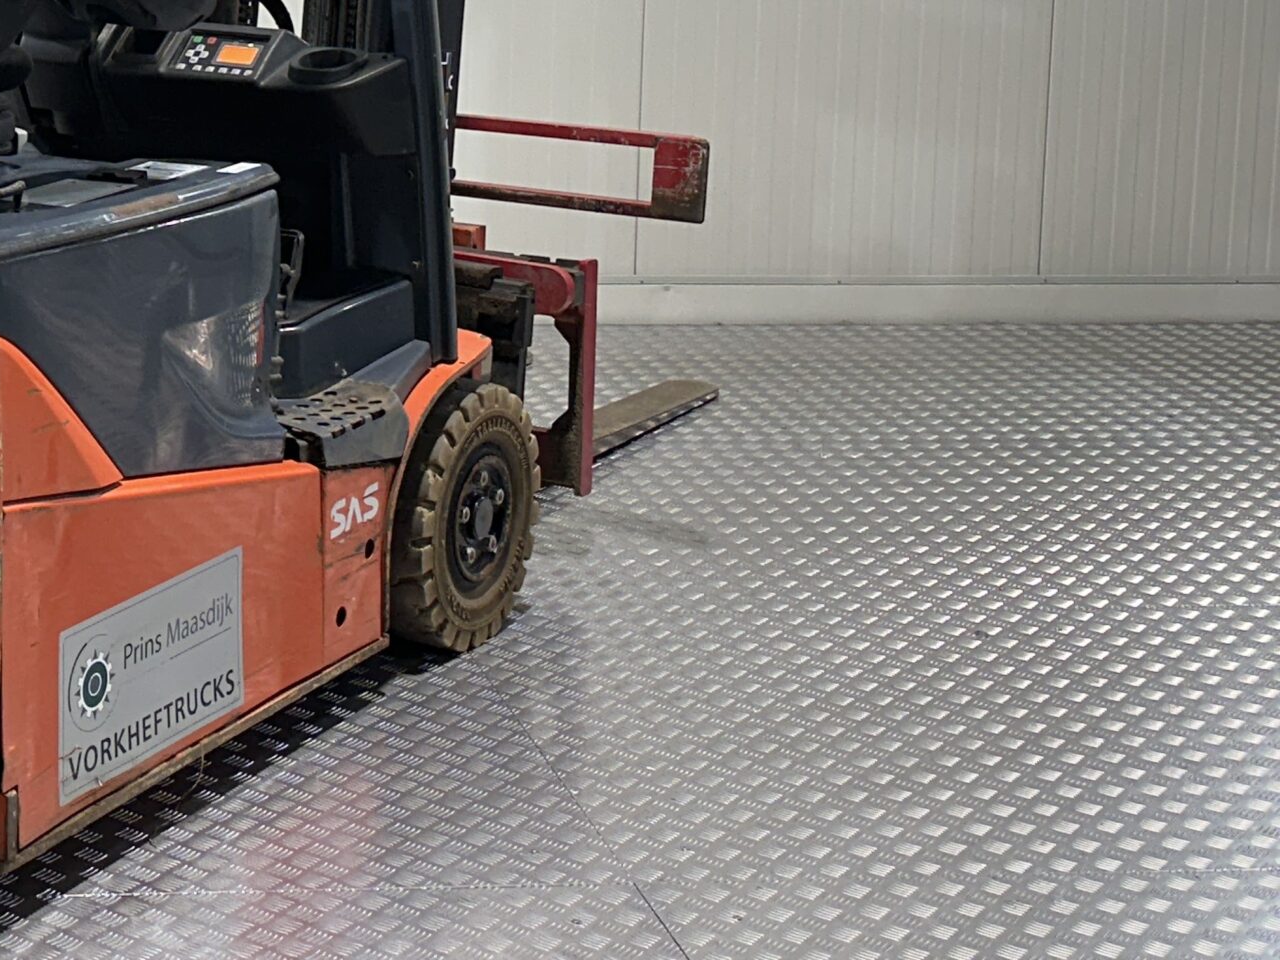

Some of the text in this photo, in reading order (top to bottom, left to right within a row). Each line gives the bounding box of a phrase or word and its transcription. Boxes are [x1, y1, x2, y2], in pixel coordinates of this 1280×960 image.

[329, 481, 380, 541] SAS
[122, 592, 234, 670] Prins Maasdijk
[68, 668, 236, 781] VORKHEFTRUCKS
